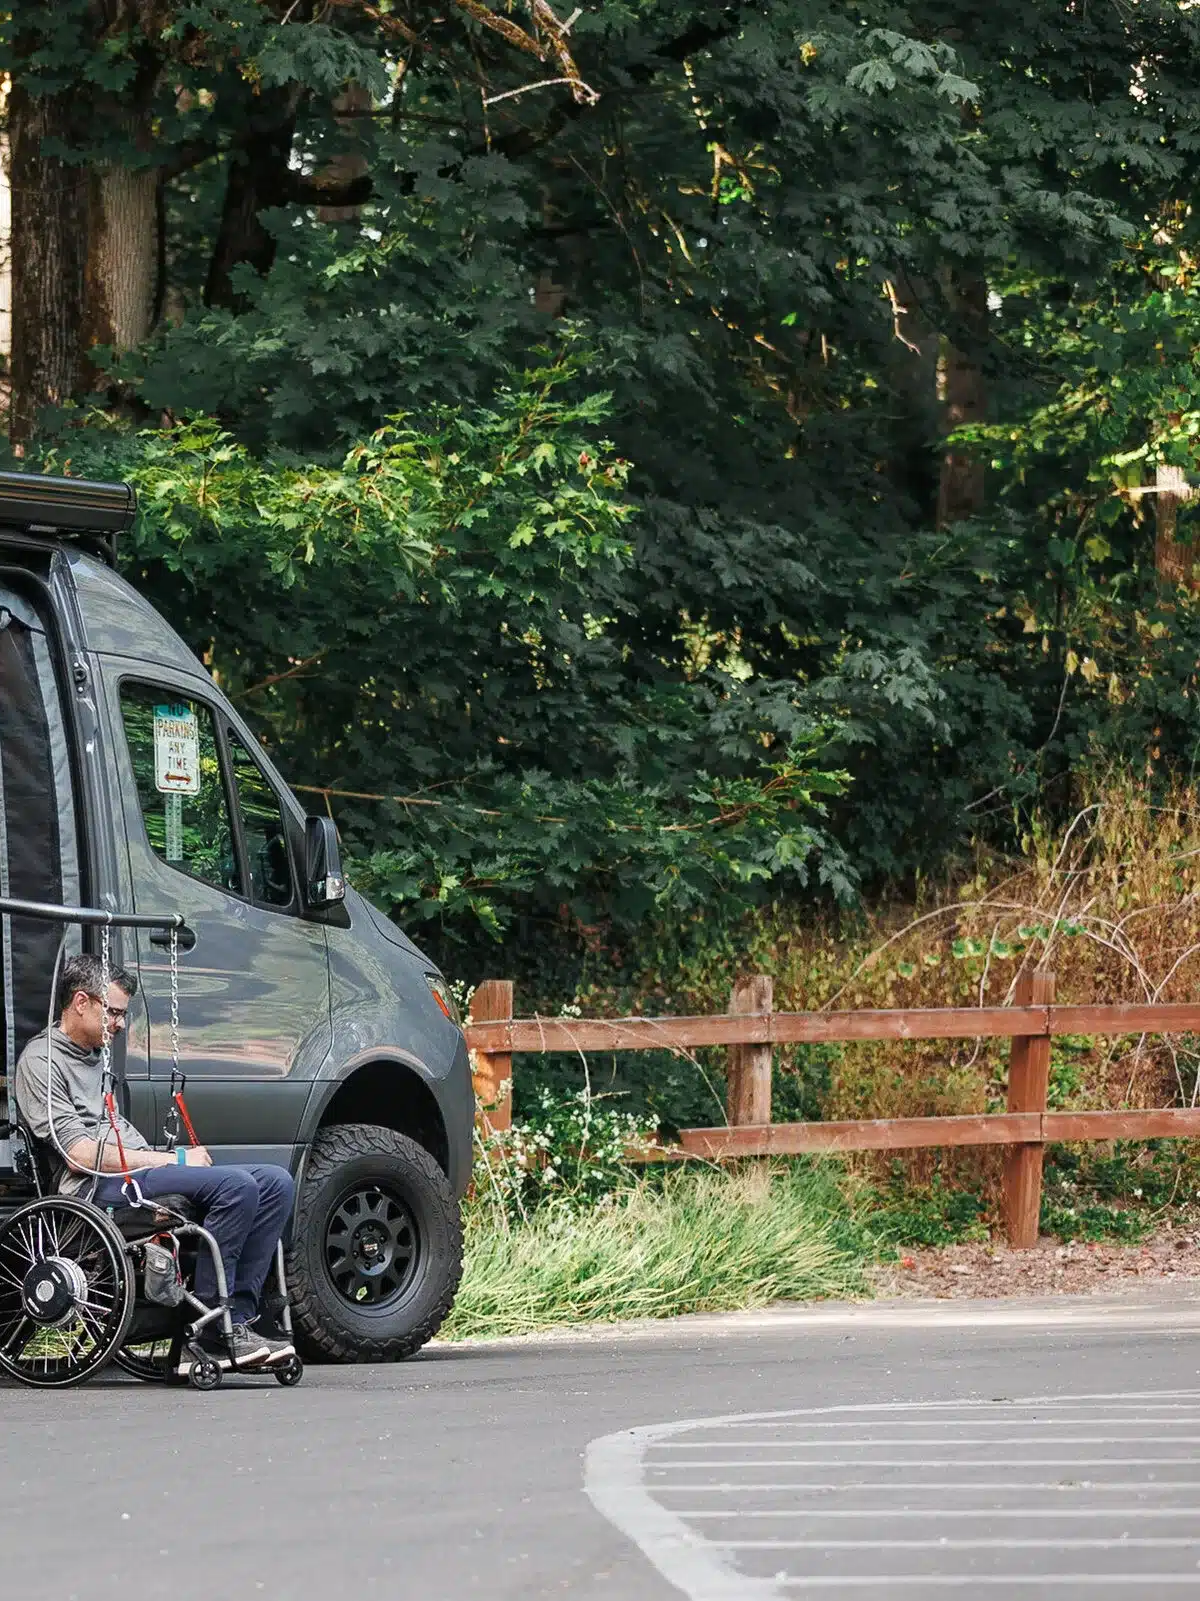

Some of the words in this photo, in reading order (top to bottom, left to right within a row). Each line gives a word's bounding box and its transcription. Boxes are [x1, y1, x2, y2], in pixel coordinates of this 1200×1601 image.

[157, 718, 194, 740] PARKING
[168, 741, 185, 754] ANY
[168, 756, 187, 771] TIME
